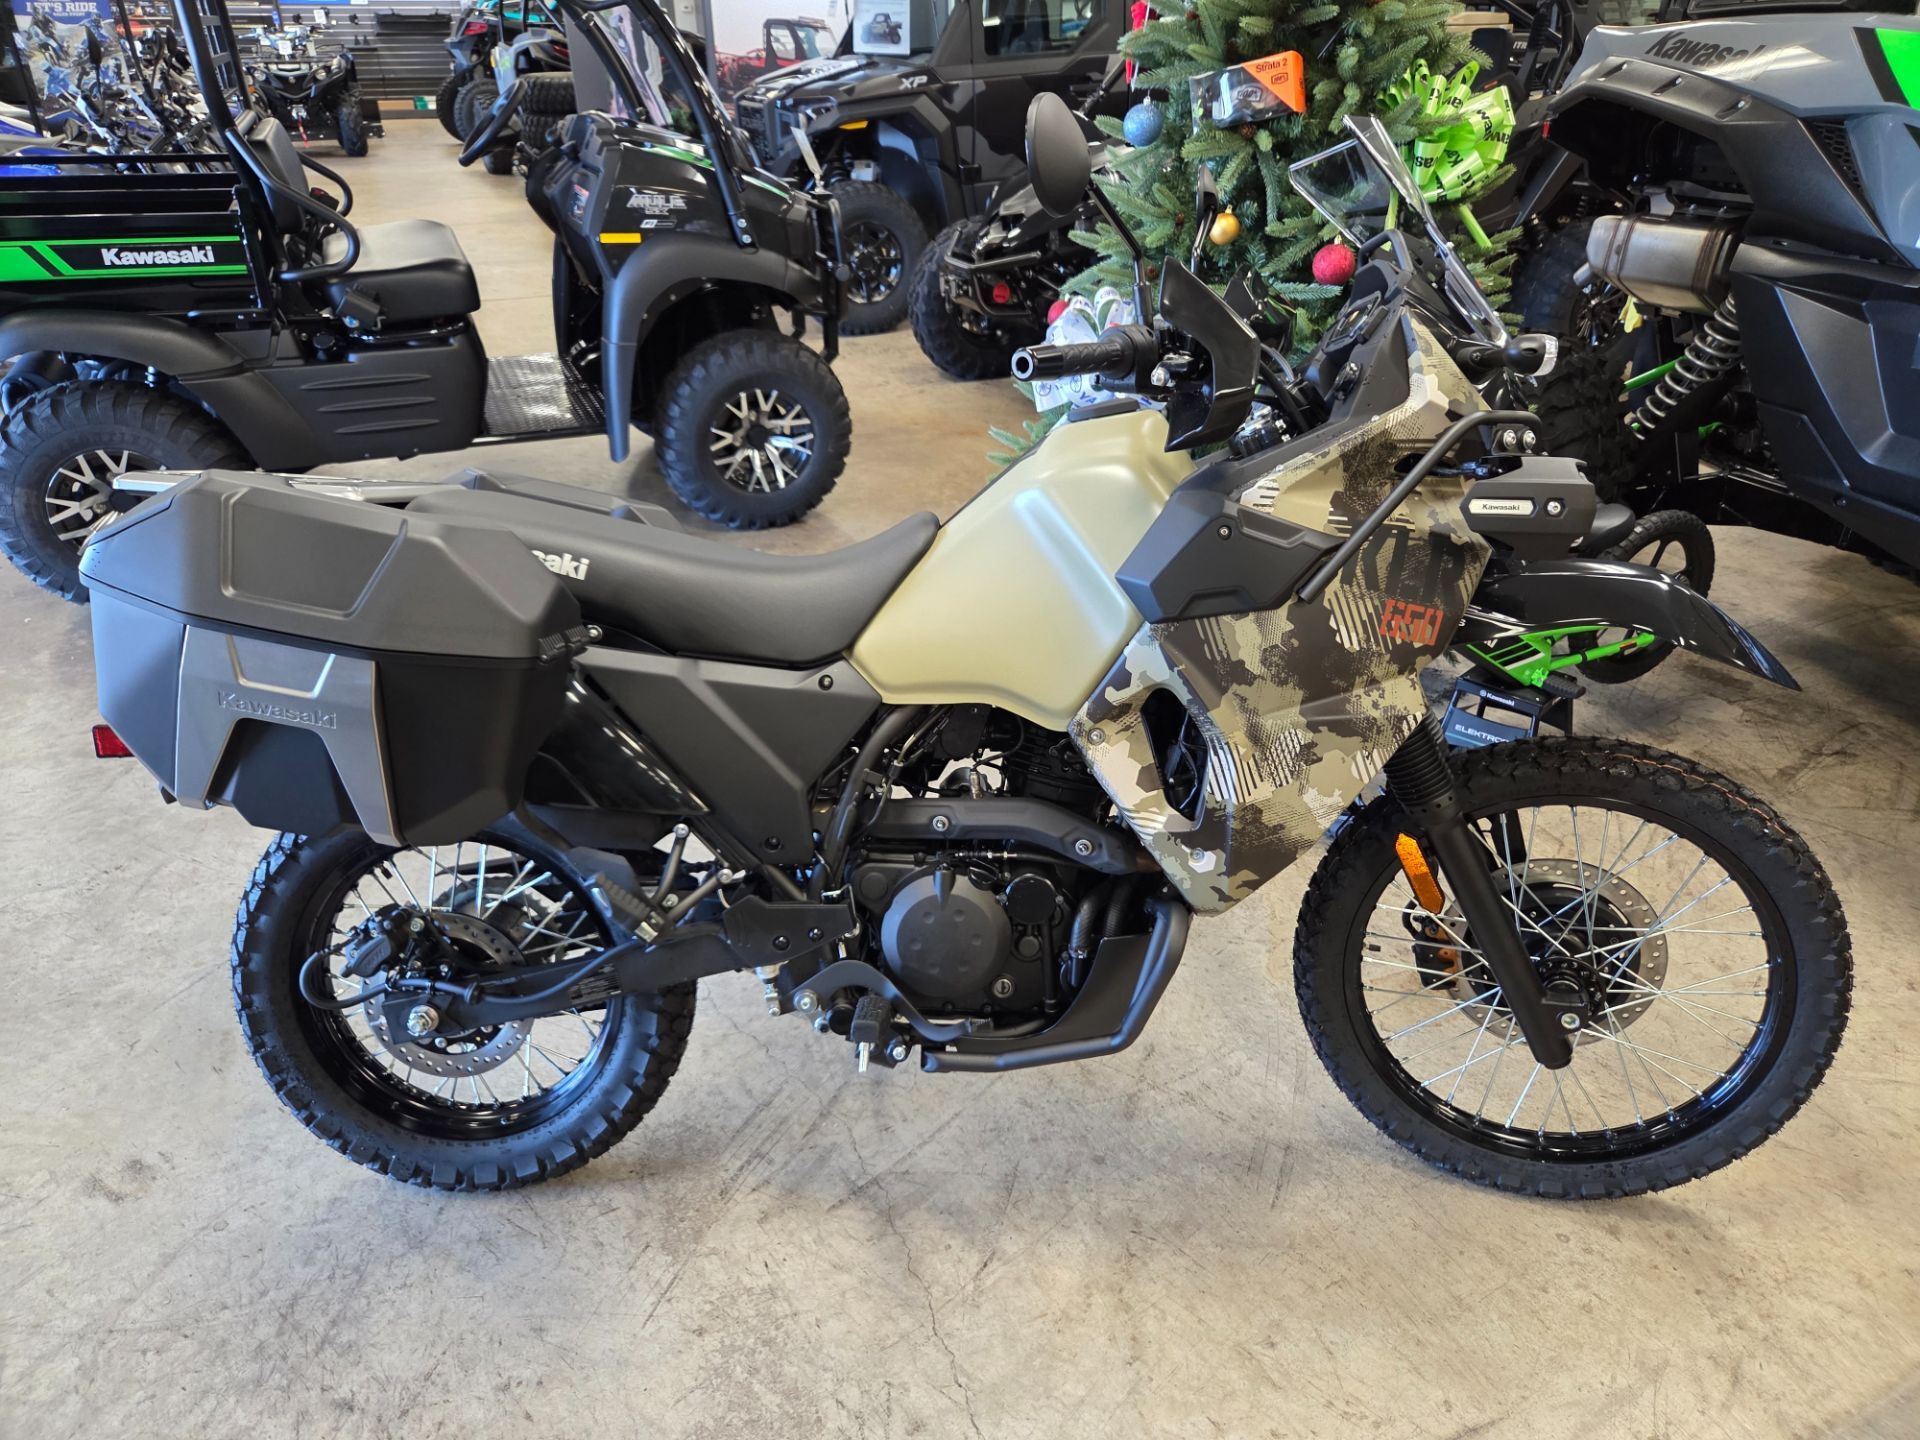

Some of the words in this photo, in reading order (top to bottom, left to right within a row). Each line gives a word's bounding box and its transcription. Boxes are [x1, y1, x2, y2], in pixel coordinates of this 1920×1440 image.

[65, 2, 98, 13] RIDE
[1645, 31, 1768, 67] Kawasa
[1256, 60, 1280, 72] Strata
[1282, 58, 1288, 66] 2
[900, 75, 928, 90] XP
[626, 194, 687, 209] MULE
[645, 207, 669, 215] SX
[101, 245, 215, 266] Kawasaki
[1379, 598, 1444, 646] 650
[1486, 692, 1515, 706] Kawasaki
[218, 691, 337, 729] Kawasaki
[1454, 724, 1510, 744] ELEKTRO
